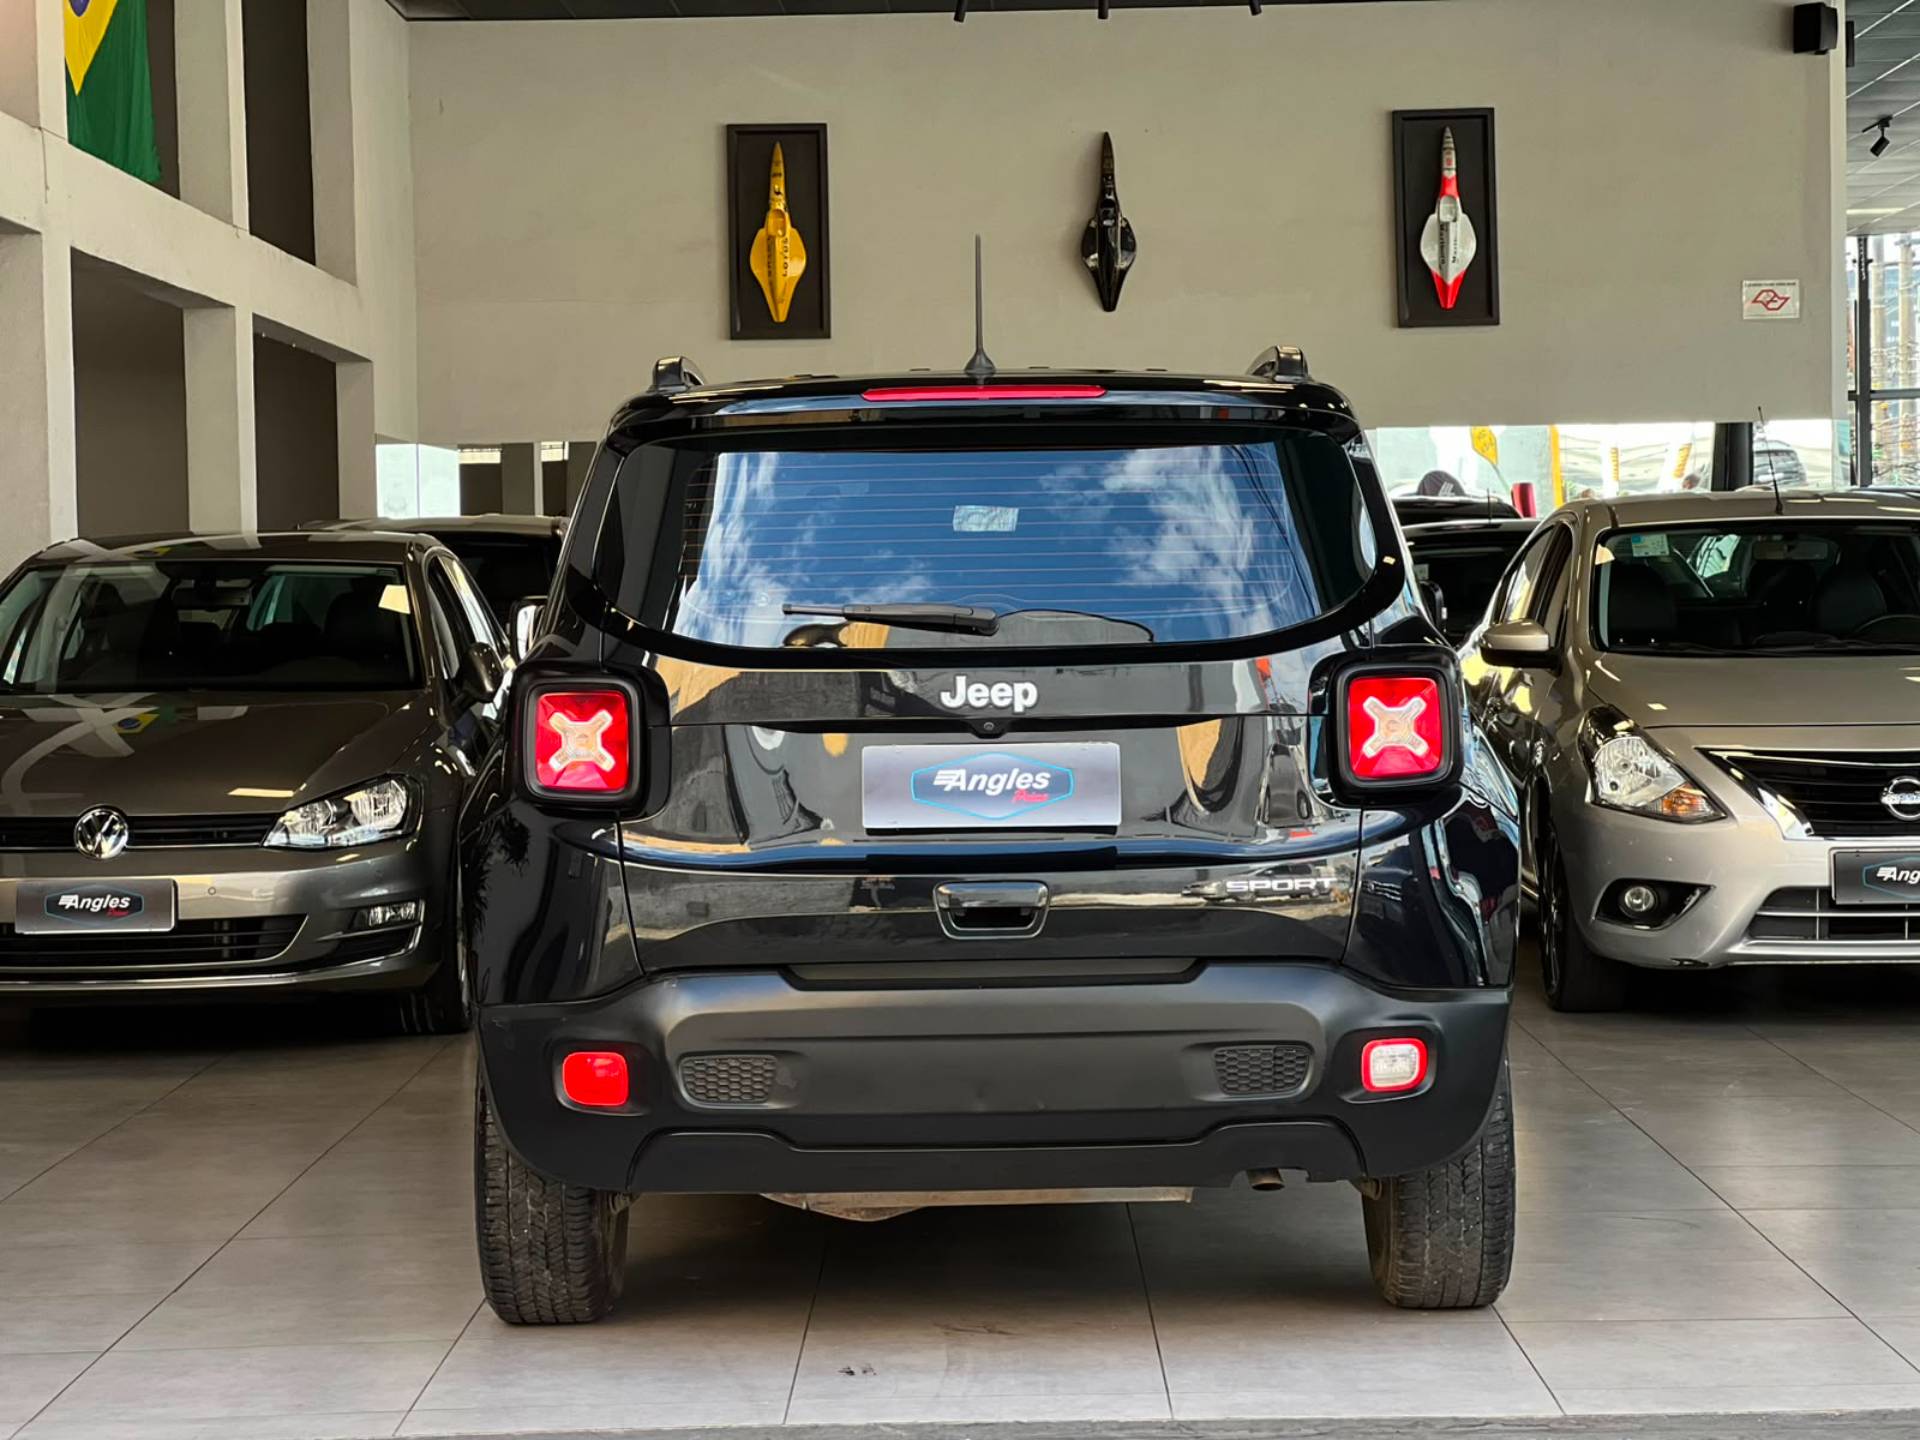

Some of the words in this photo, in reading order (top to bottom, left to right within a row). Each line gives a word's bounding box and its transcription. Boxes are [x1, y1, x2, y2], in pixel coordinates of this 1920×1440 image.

[940, 675, 1038, 713] Jeep
[933, 768, 1051, 796] Angles
[1226, 877, 1338, 893] SPORT
[58, 893, 131, 912] Angles
